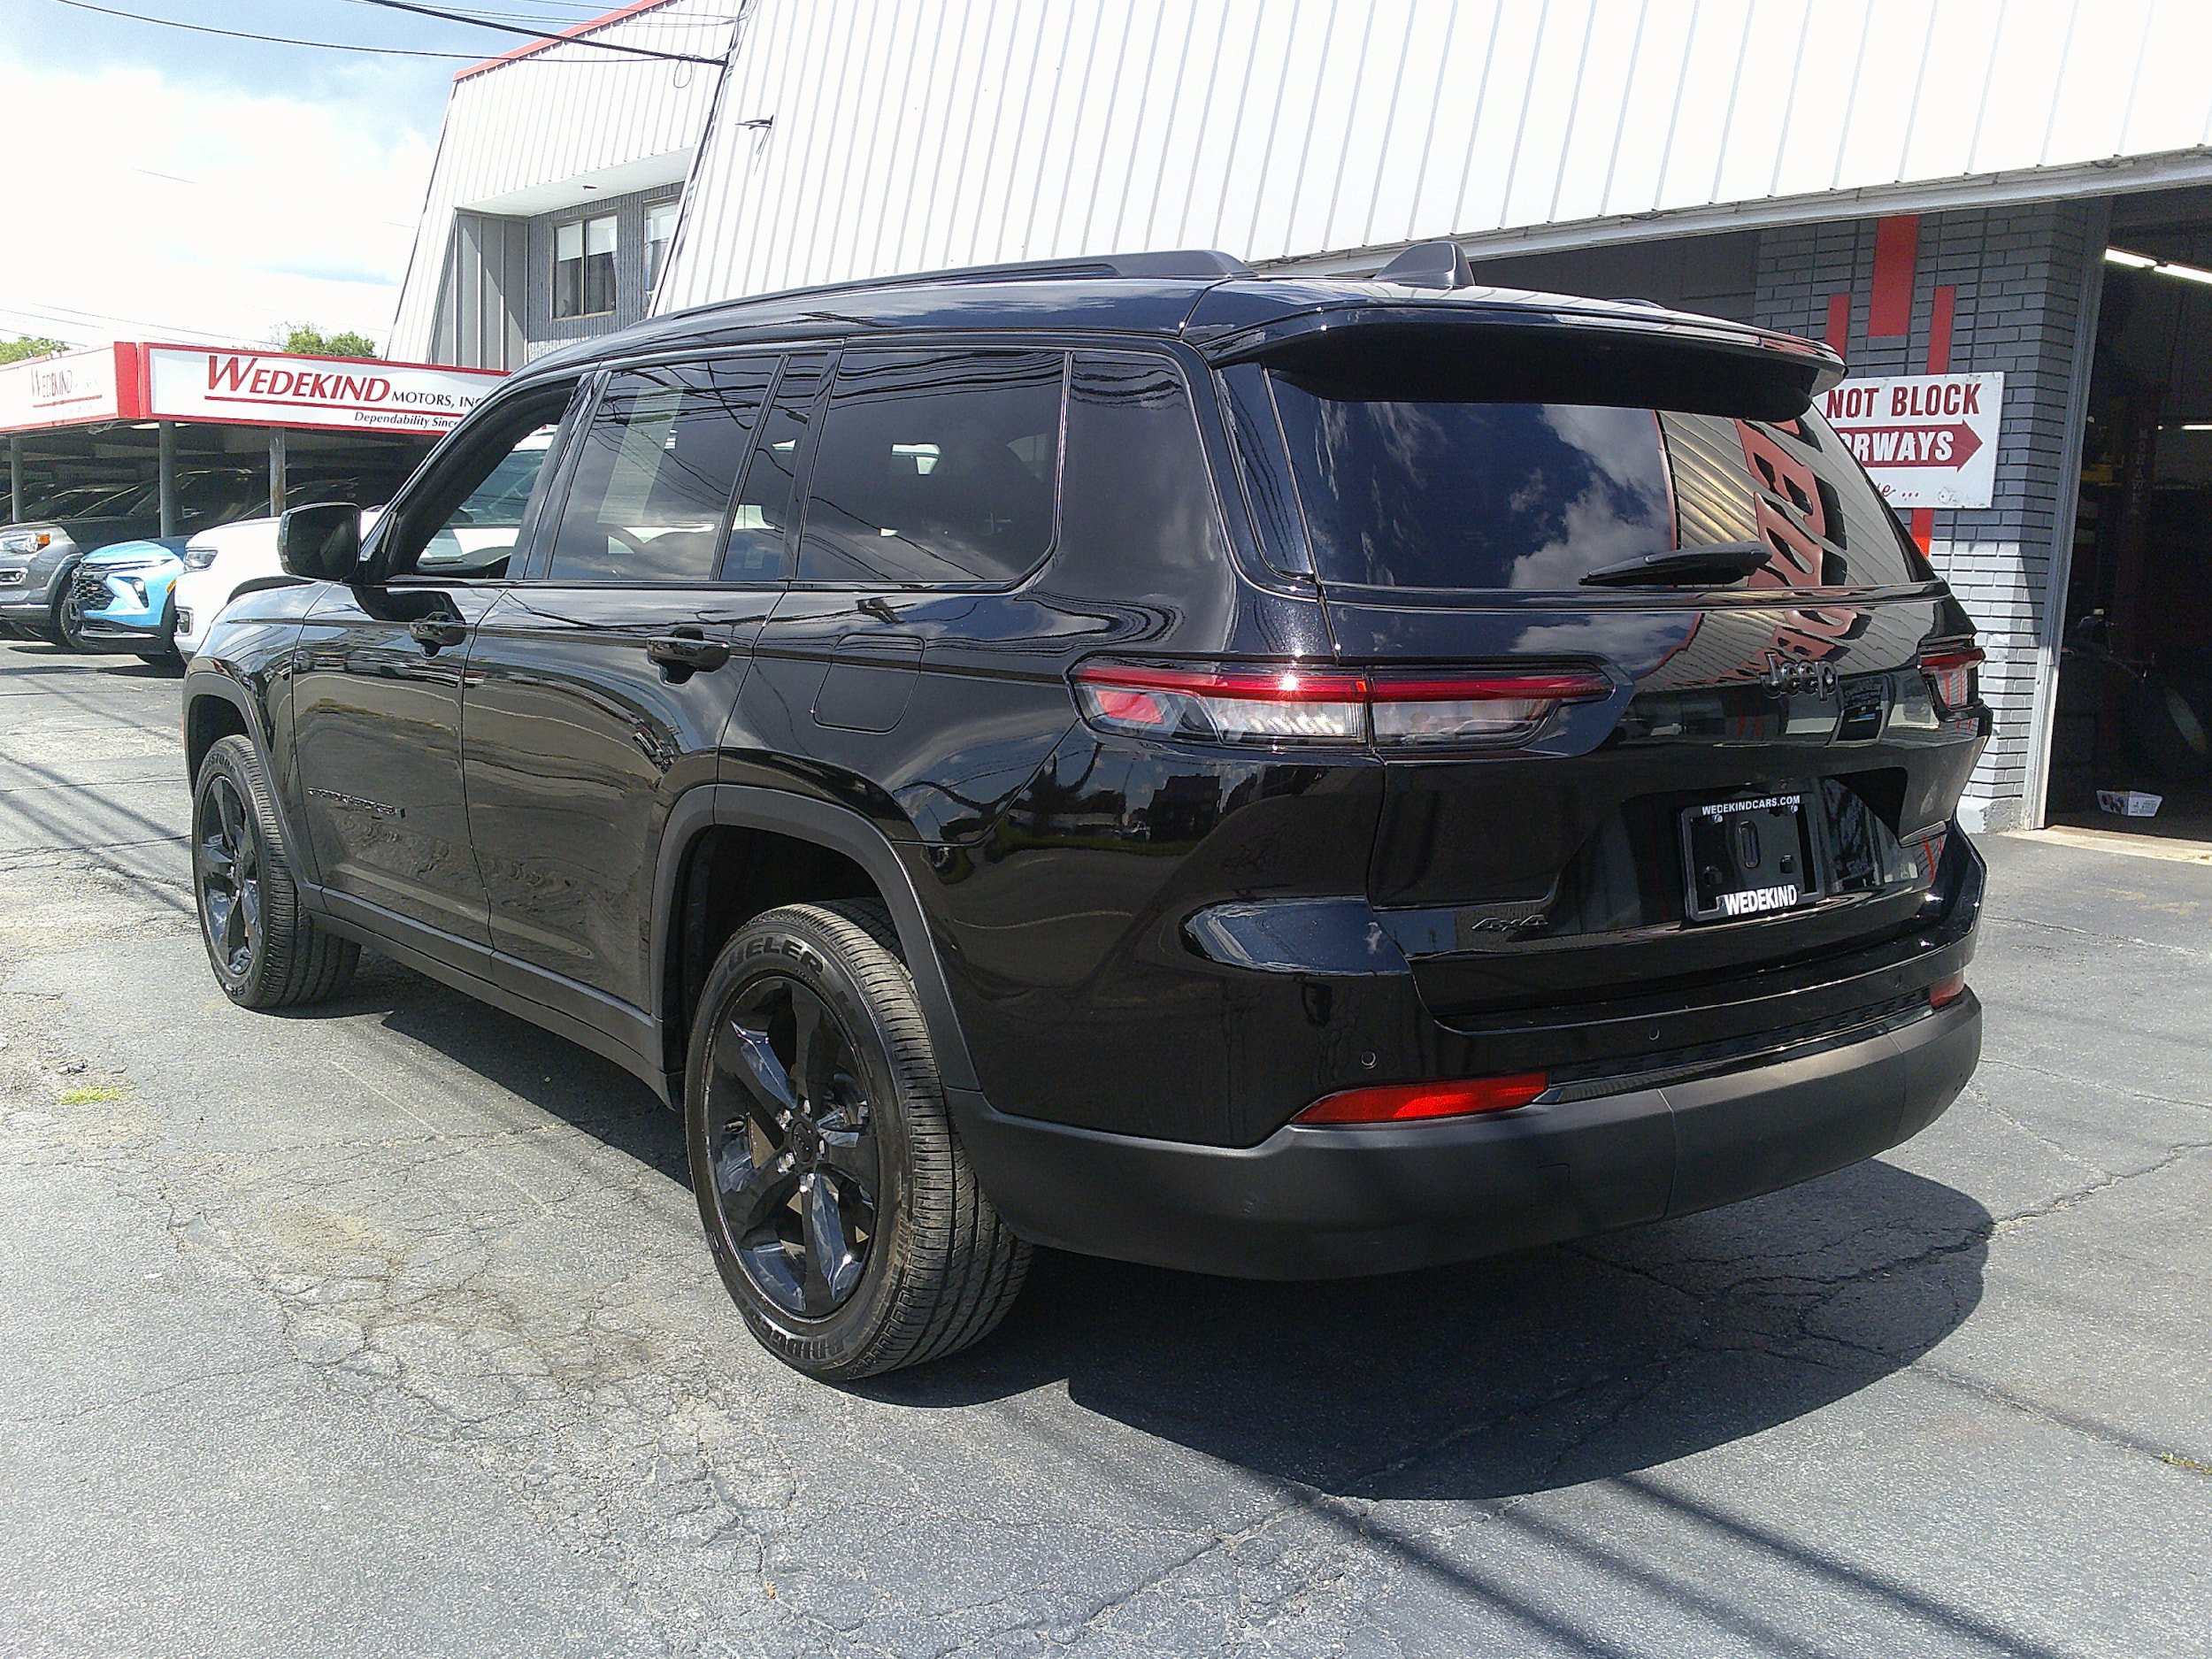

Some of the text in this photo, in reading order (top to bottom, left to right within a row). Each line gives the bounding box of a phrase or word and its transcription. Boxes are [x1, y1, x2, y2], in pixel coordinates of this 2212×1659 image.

[209, 356, 390, 402] WEDEKIND
[392, 391, 455, 409] MOTORS,
[1826, 383, 1982, 419] NOT BLOCK
[354, 411, 430, 429] Dependability
[1759, 653, 1839, 702] Jeep
[1702, 795, 1800, 816] WEDEKINDCARS.COM
[1724, 885, 1798, 915] WEDEKIND
